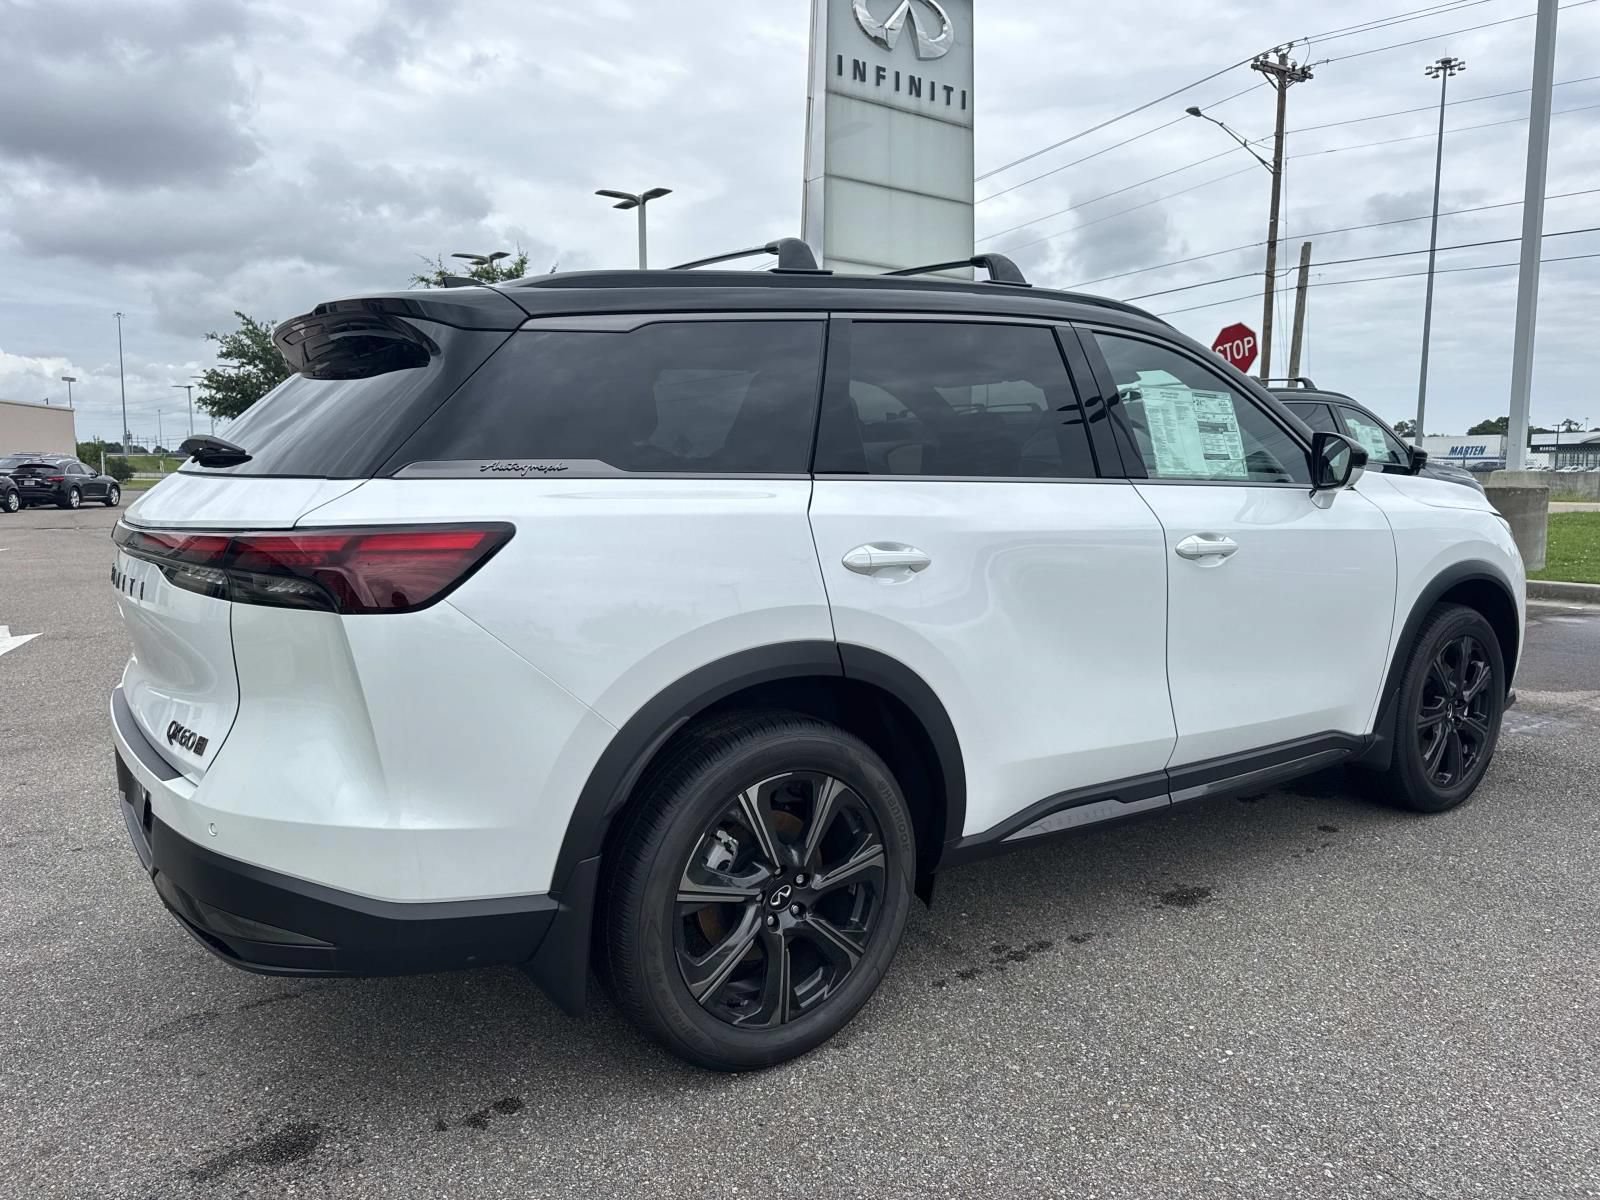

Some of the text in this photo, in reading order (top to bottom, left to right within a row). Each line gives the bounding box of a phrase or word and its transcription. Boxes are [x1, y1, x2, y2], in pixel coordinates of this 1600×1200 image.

[836, 54, 967, 110] INFINITI
[1448, 445, 1487, 456] MARTEN
[166, 719, 198, 751] QX60
